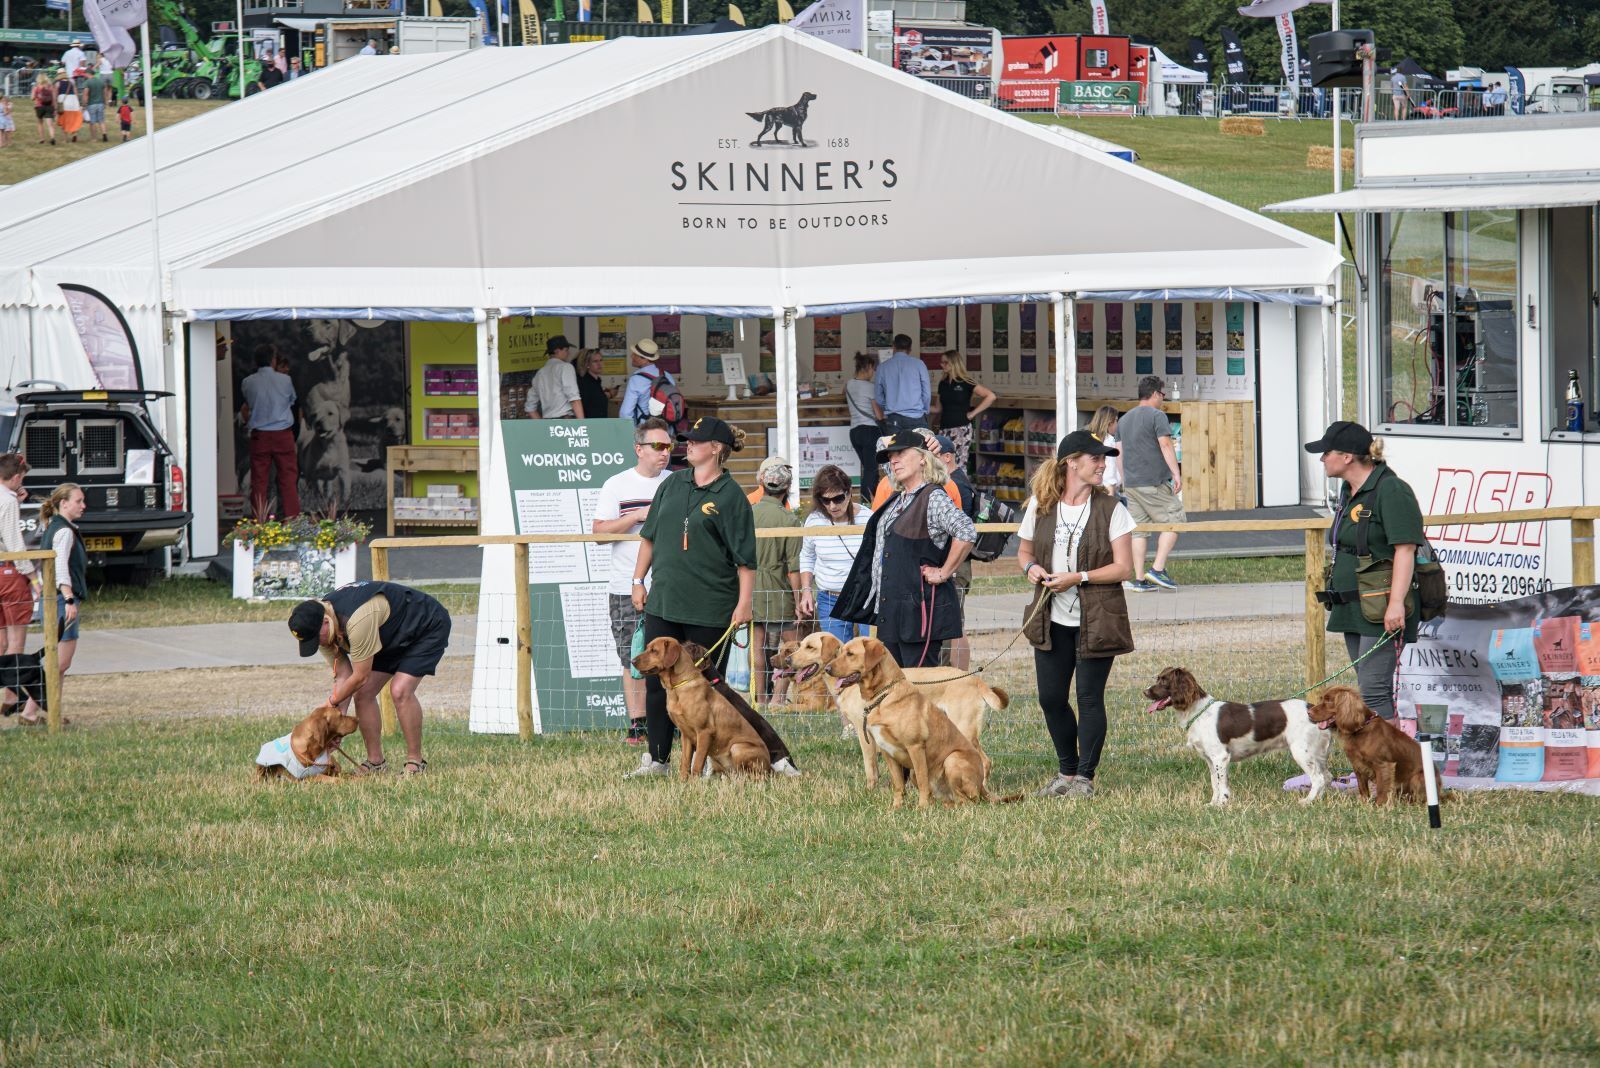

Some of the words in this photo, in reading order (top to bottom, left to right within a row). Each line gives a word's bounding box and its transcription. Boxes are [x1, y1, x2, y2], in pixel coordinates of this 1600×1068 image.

[1074, 85, 1112, 98] BASC
[718, 139, 740, 149] EST.
[827, 138, 850, 148] 1688
[671, 158, 898, 191] SKINNER'S
[683, 217, 726, 228] BORN
[738, 218, 758, 229] TO
[769, 218, 787, 229] BE
[798, 214, 888, 229] OUTDOORS
[554, 425, 588, 437] GAME
[568, 438, 589, 448] FAIR
[521, 454, 587, 467] WORKING
[591, 452, 624, 465] DOG
[558, 469, 592, 482] RING
[1431, 548, 1541, 570] COMMUNICATIONS
[1455, 571, 1497, 593] 01923
[1502, 575, 1552, 596] 209640
[1410, 683, 1422, 691] TO
[1442, 683, 1483, 692] OUTDOORS
[591, 694, 625, 707] GAME
[605, 707, 627, 717] FAIR
